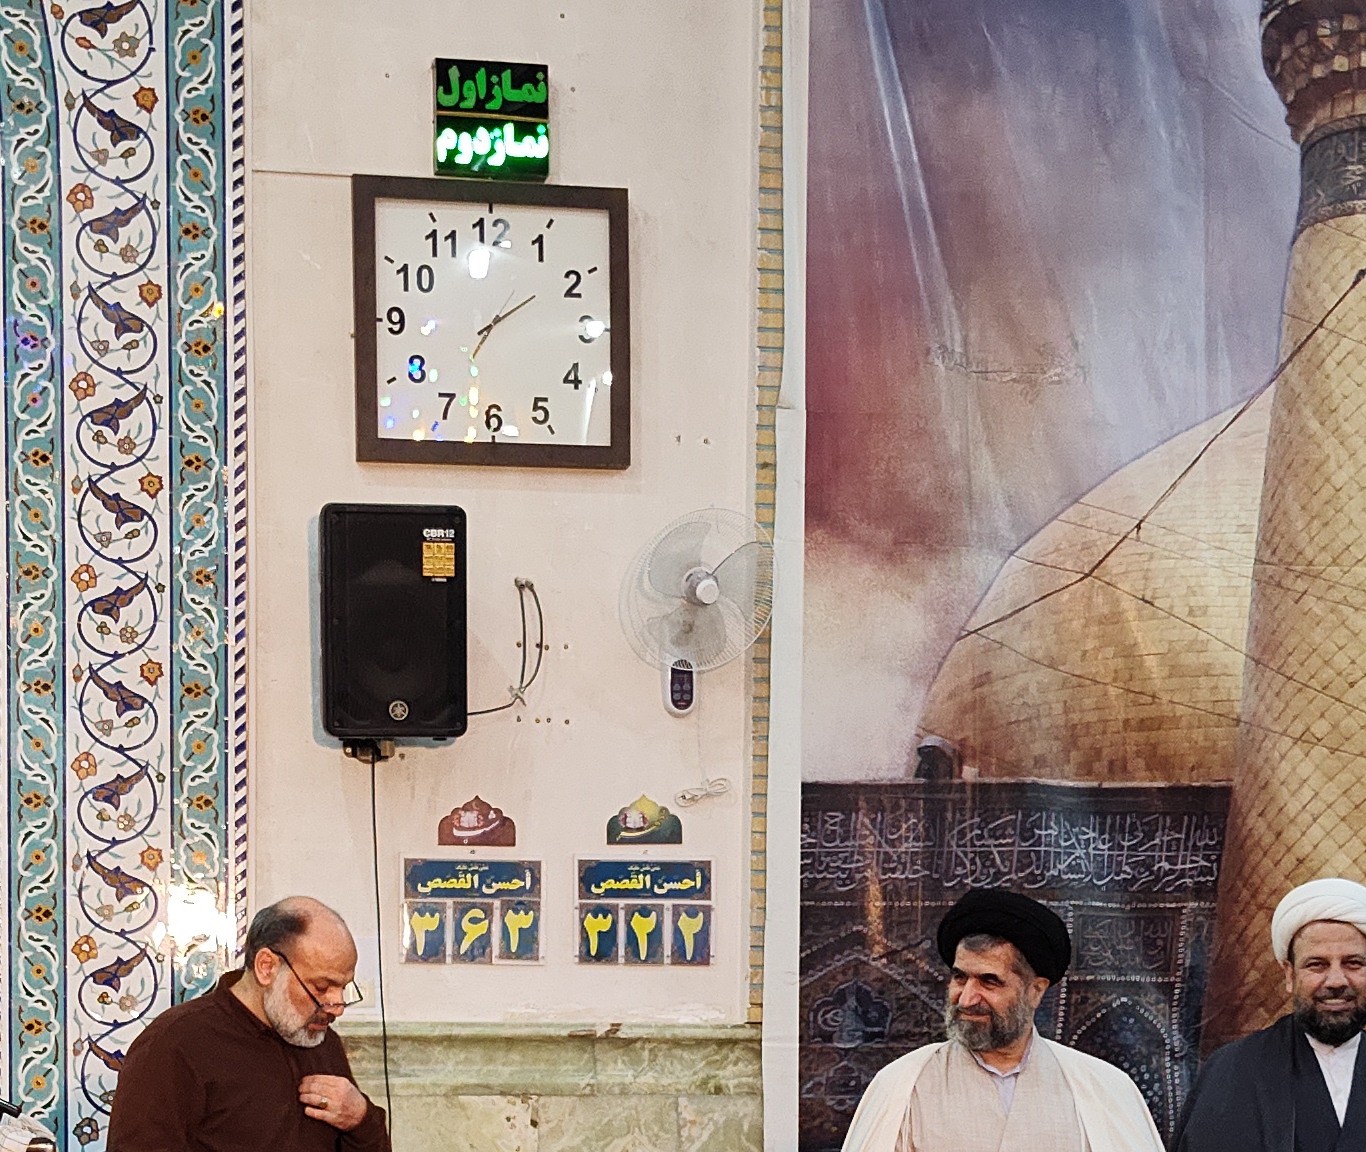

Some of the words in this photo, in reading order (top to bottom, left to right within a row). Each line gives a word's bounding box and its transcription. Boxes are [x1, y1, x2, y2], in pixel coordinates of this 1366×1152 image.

[437, 65, 487, 107] اول
[485, 69, 547, 110] نماز
[436, 126, 492, 165] دوم
[486, 122, 549, 166] نماز
[425, 229, 458, 259] 11
[472, 217, 512, 248] 12
[532, 234, 545, 262] 1
[396, 263, 435, 294] 10
[564, 270, 583, 299] 2
[386, 307, 406, 335] 9
[407, 355, 427, 383] 8
[563, 362, 583, 391] 4
[438, 393, 457, 421] 7
[484, 404, 503, 433] 6
[532, 397, 550, 426] 5
[423, 528, 455, 538] CBR12
